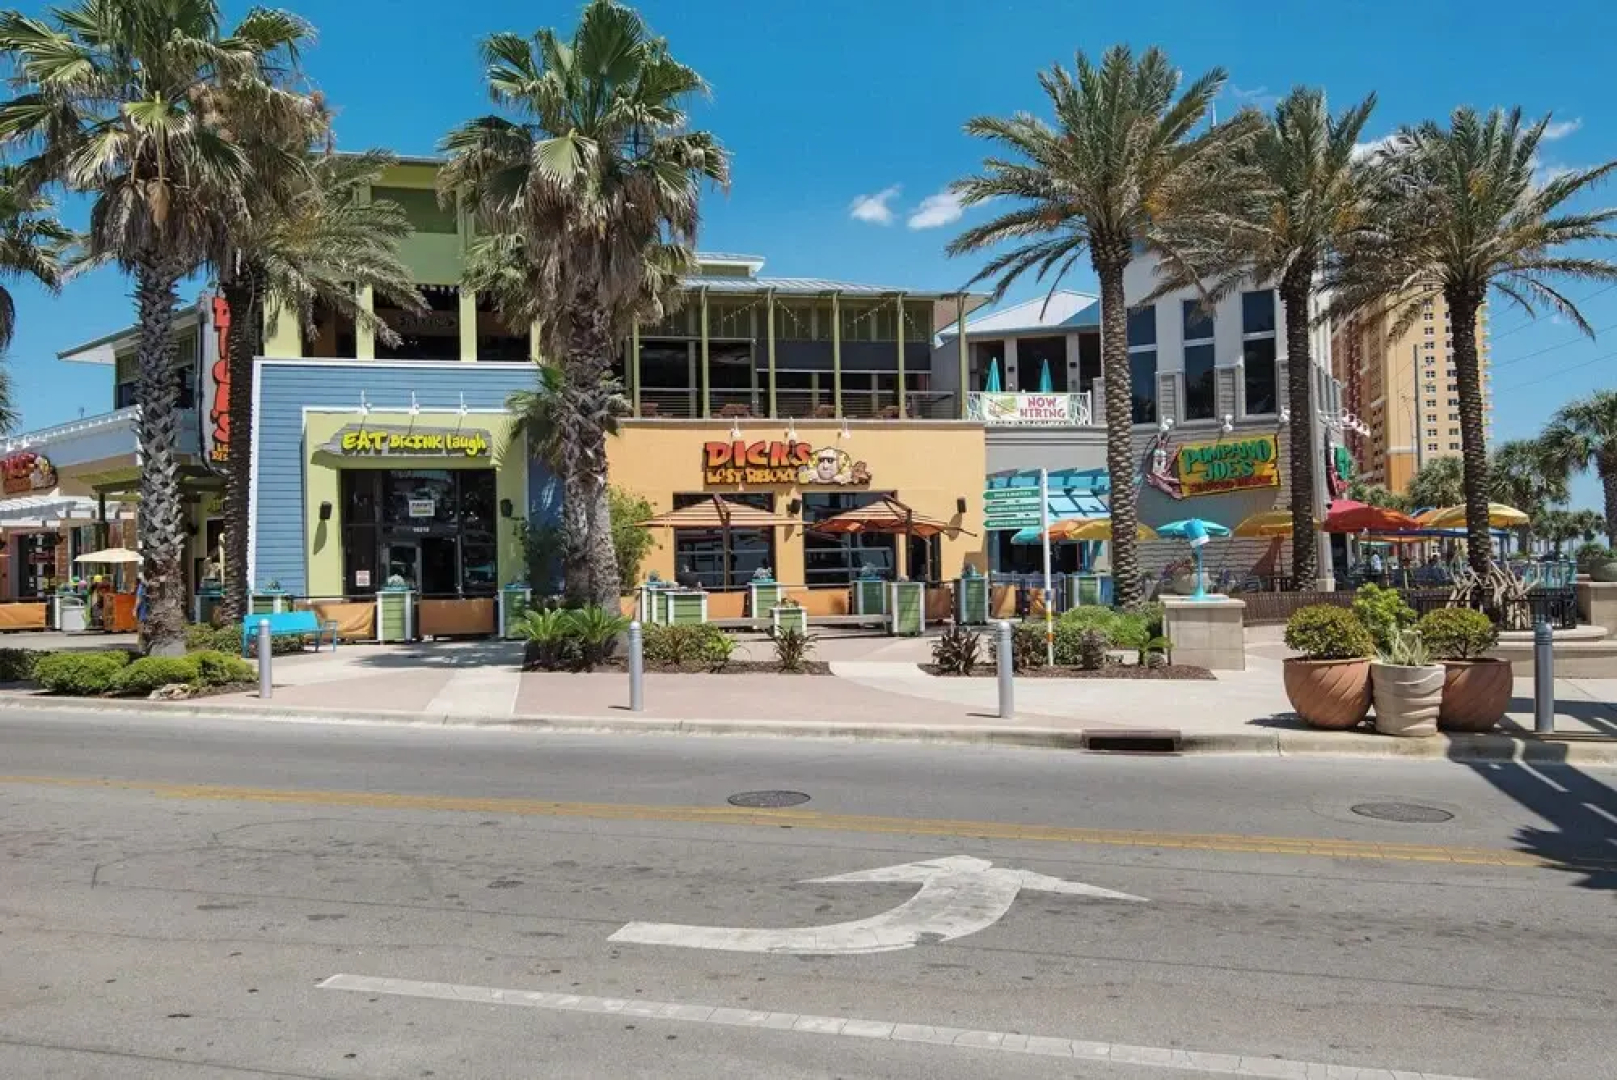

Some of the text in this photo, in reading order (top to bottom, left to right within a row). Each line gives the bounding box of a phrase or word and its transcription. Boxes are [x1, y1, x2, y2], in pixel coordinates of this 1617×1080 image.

[1028, 397, 1057, 408] NOW
[1020, 408, 1066, 418] HIRING
[342, 430, 387, 450] EAT
[446, 432, 486, 455] laugh
[705, 440, 812, 467] DICK'S
[1182, 439, 1272, 475] POMPANO
[707, 468, 743, 483] LAST
